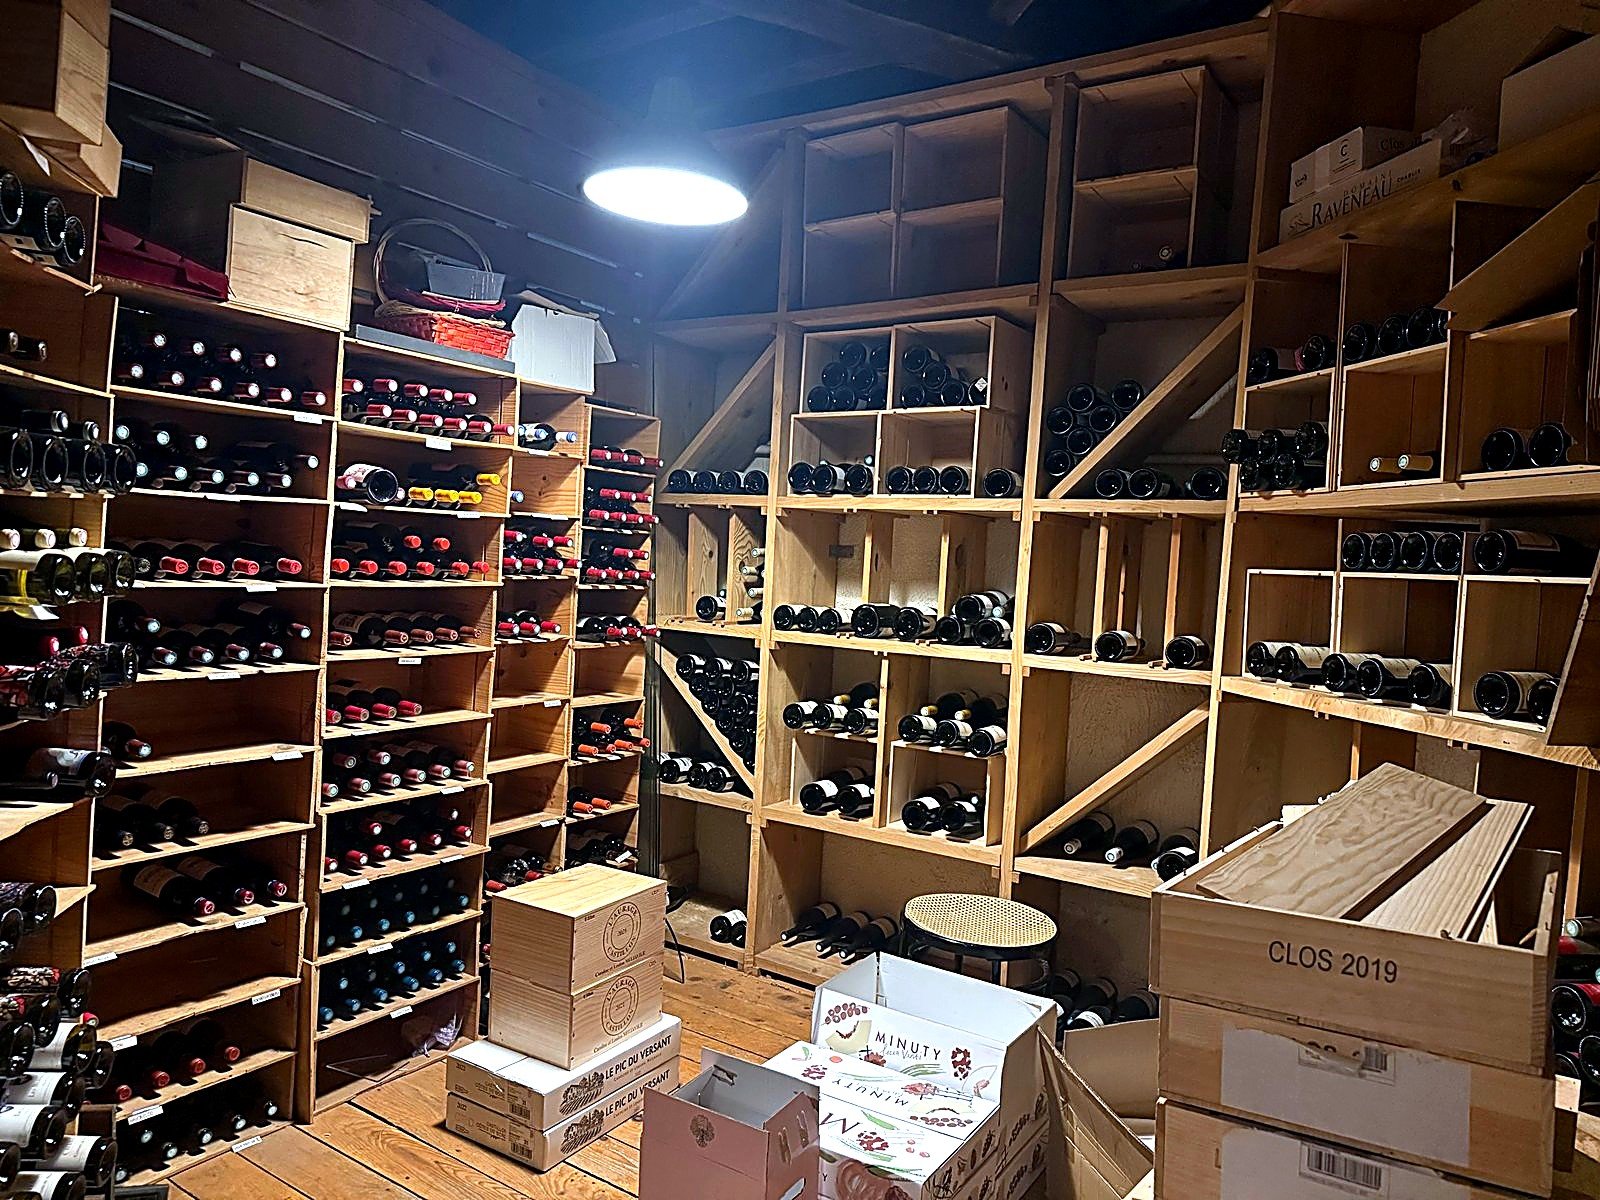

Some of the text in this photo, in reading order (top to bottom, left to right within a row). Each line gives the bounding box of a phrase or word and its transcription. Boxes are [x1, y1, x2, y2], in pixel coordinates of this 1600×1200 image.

[1311, 175, 1393, 229] RAVENEAU
[1268, 939, 1399, 984] CLOS 2019
[605, 1067, 614, 1080] LE
[615, 1060, 627, 1074] PIC
[628, 1054, 639, 1067] DU
[640, 1035, 672, 1059] VERSANT
[875, 1030, 941, 1061] MINUTY
[605, 1104, 614, 1117] LE
[615, 1096, 626, 1111] PIC
[627, 1089, 638, 1103] DU
[832, 1079, 909, 1106] MINUTY
